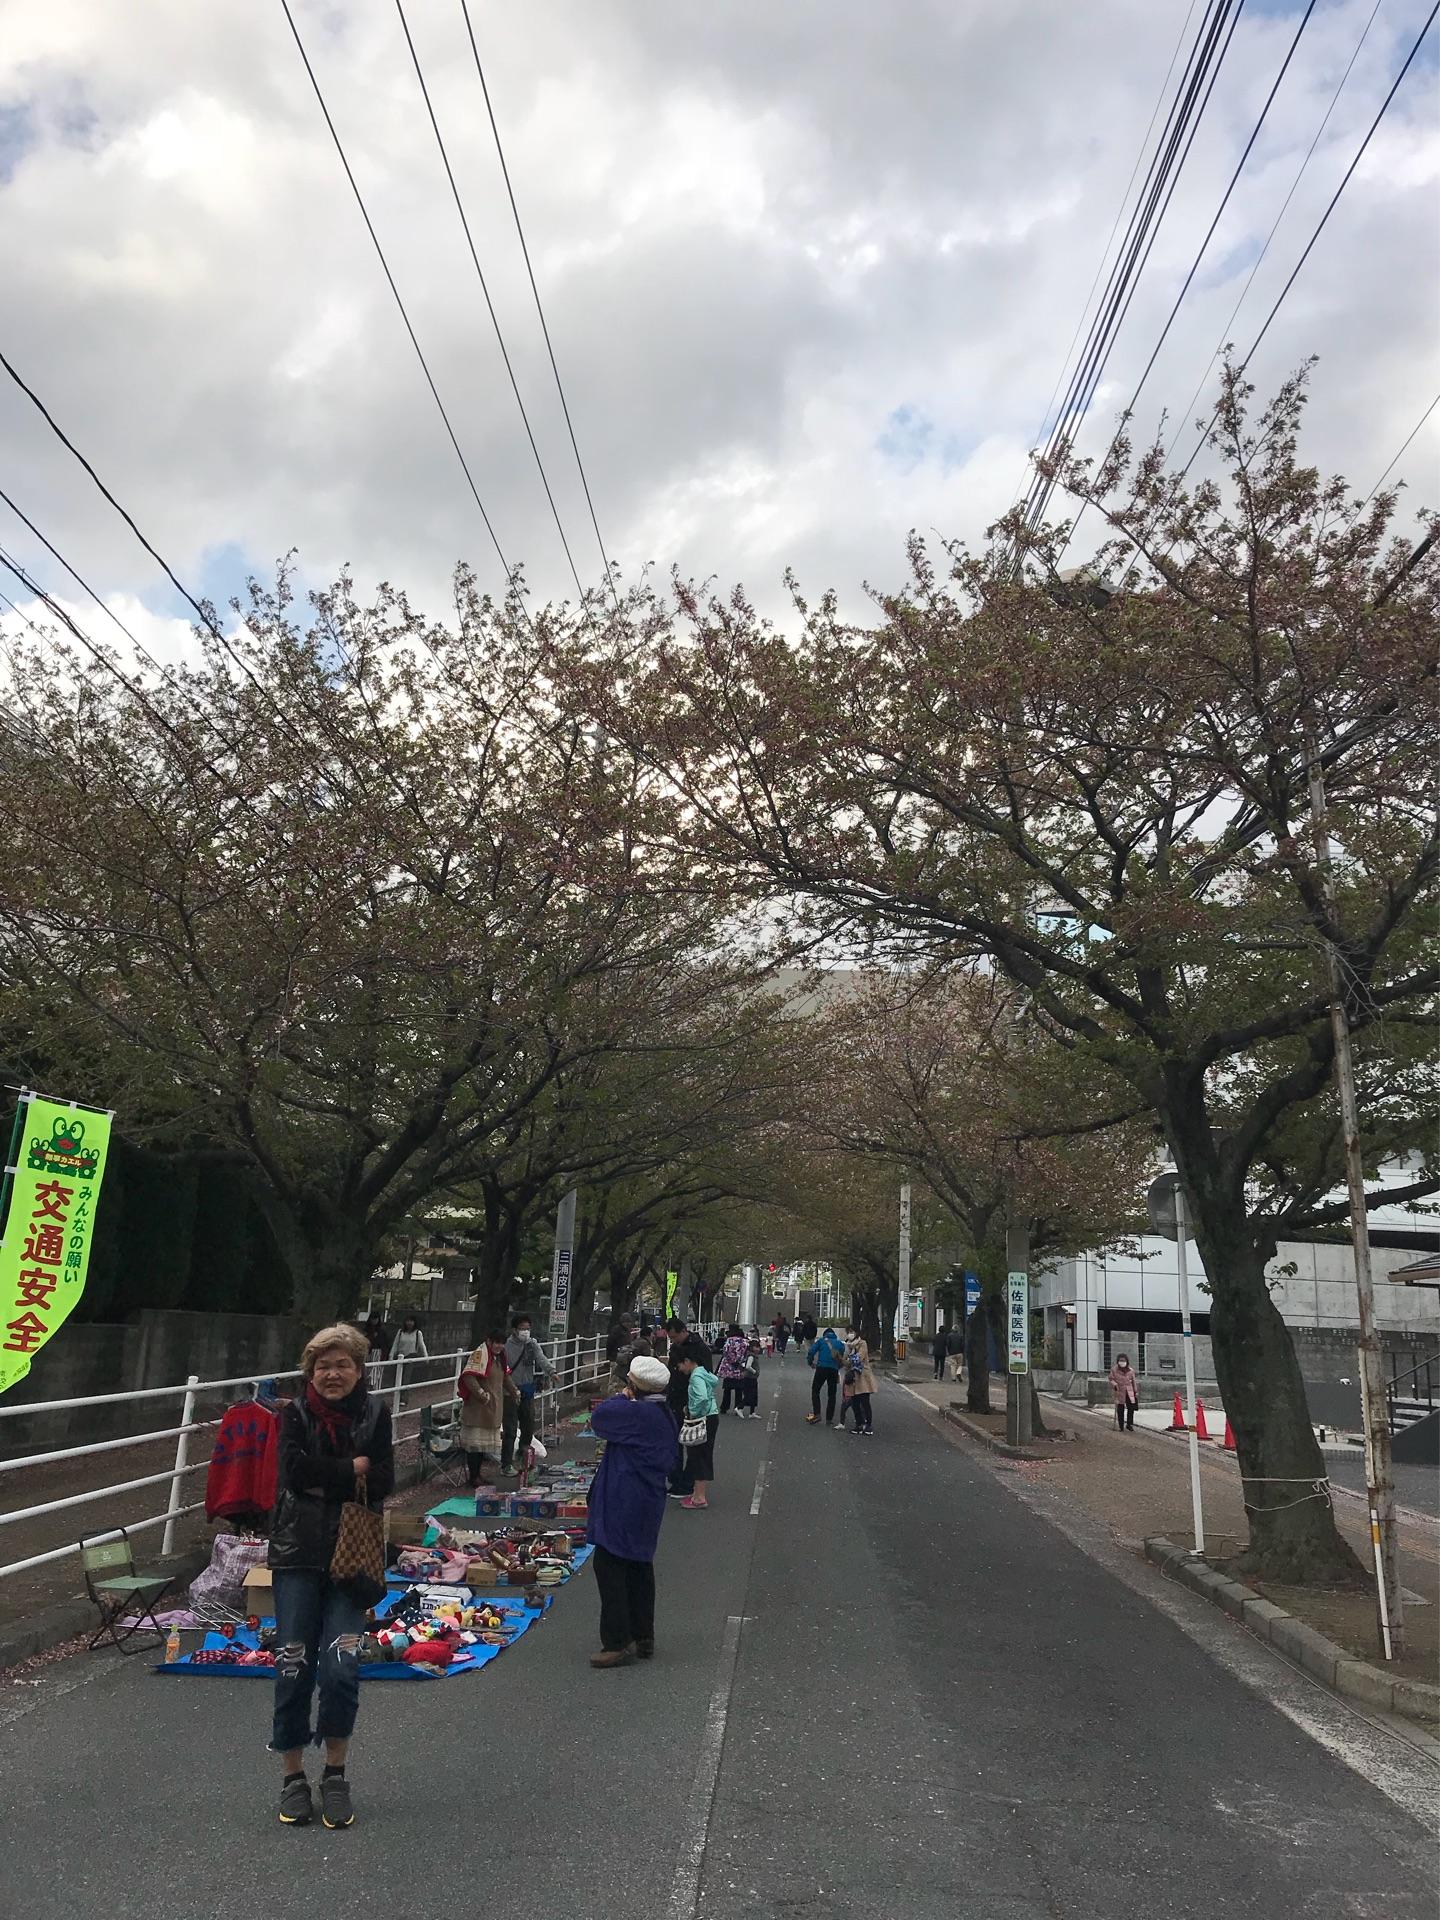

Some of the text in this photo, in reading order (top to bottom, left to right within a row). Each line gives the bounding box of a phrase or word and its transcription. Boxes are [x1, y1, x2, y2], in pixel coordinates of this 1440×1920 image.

[3, 1180, 74, 1353] 交通安全
[64, 1186, 92, 1283] みんなの願い
[557, 1252, 569, 1309] 三浦皮フ科
[1011, 1289, 1024, 1343] 佐藤医院
